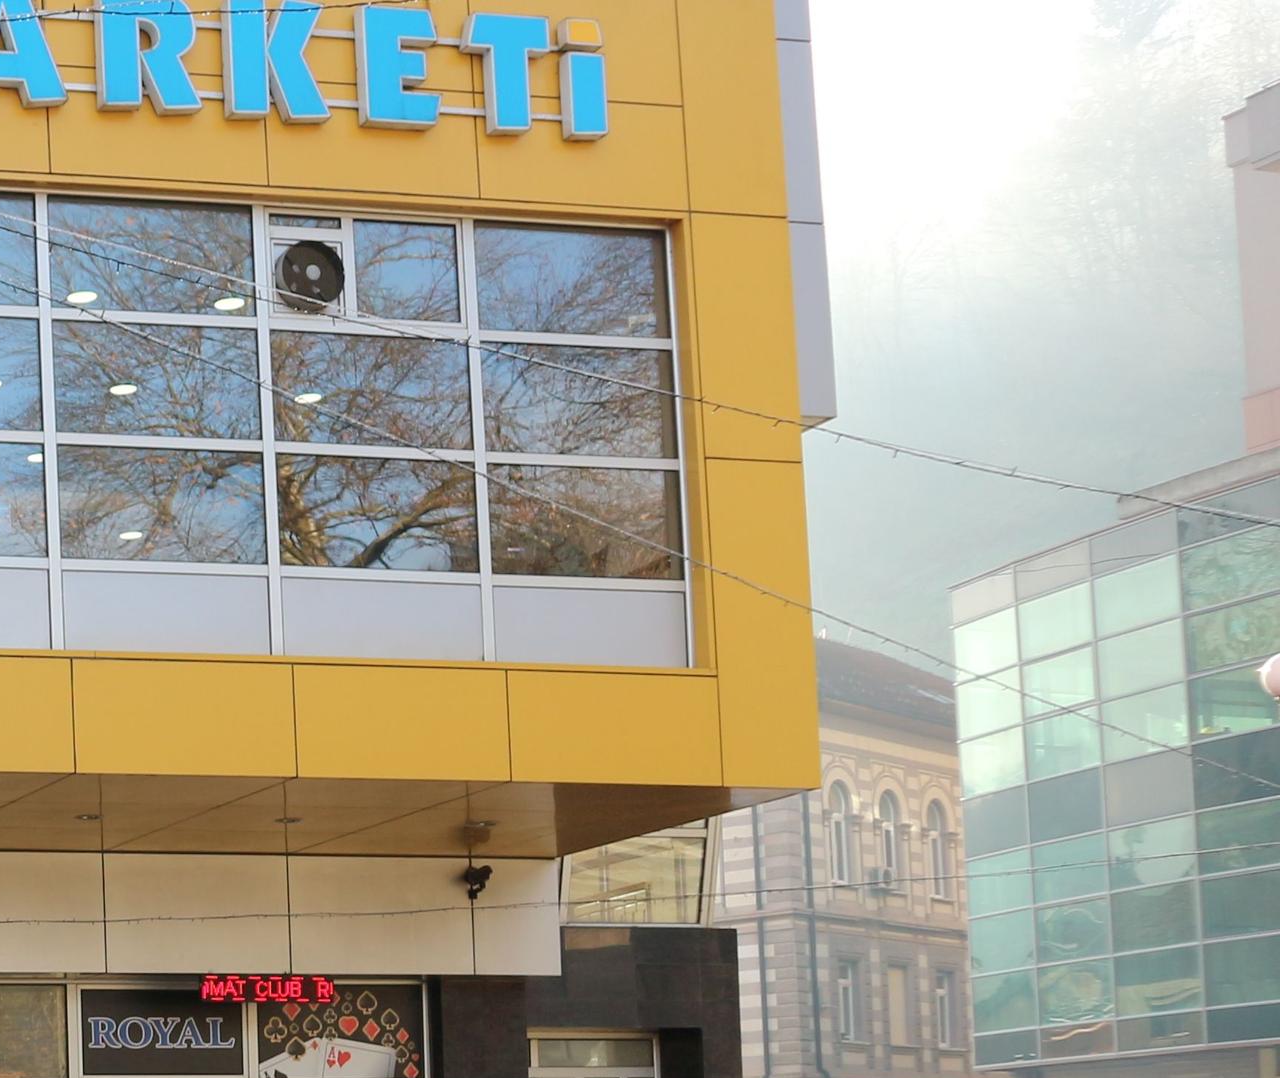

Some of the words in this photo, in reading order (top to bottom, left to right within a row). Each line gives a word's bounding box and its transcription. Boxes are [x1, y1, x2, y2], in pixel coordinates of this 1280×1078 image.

[205, 980, 247, 997] MAT
[255, 980, 302, 998] CLUB
[88, 1017, 236, 1049] ROYAL
